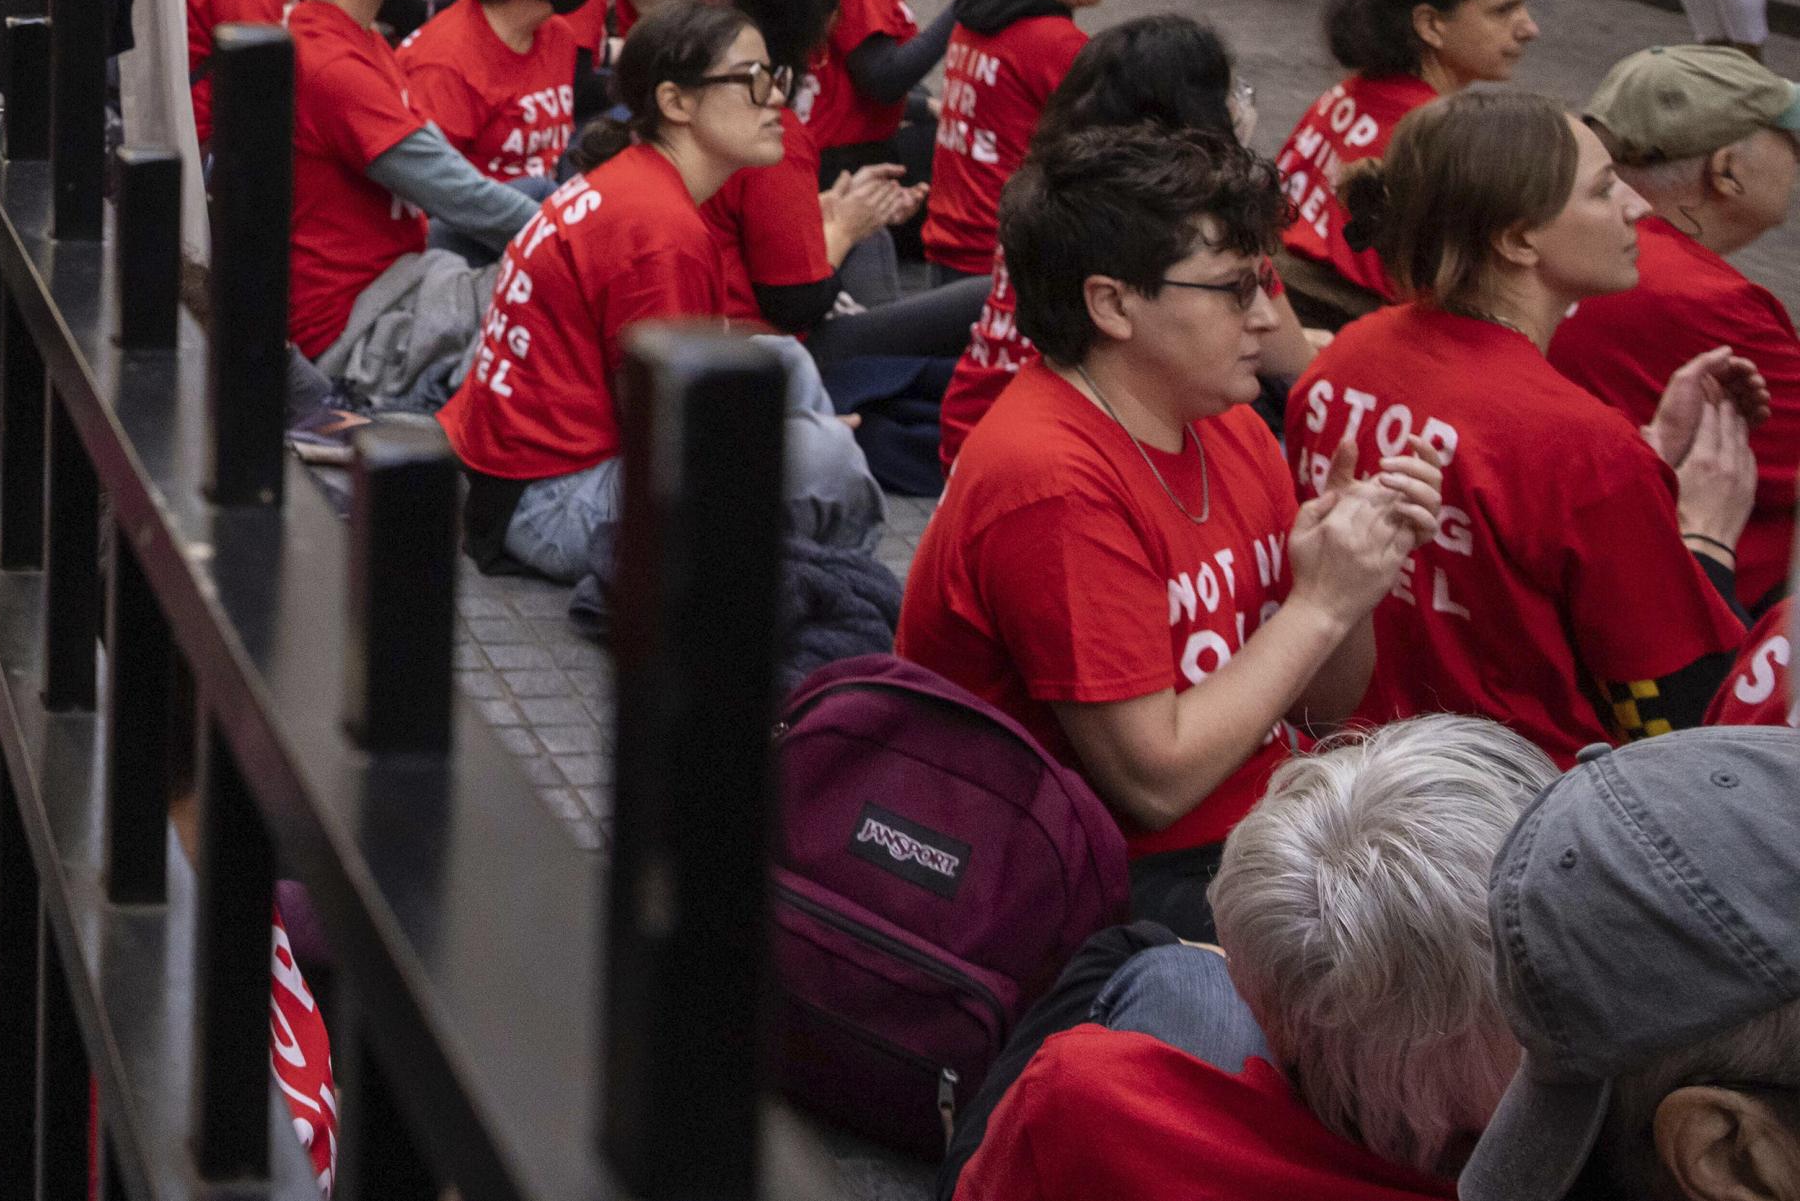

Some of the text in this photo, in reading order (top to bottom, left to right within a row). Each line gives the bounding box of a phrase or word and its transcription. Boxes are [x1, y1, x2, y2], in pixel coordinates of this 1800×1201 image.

[1316, 84, 1379, 147] TOP
[1306, 379, 1459, 468] STOP
[1167, 547, 1236, 627] NOT
